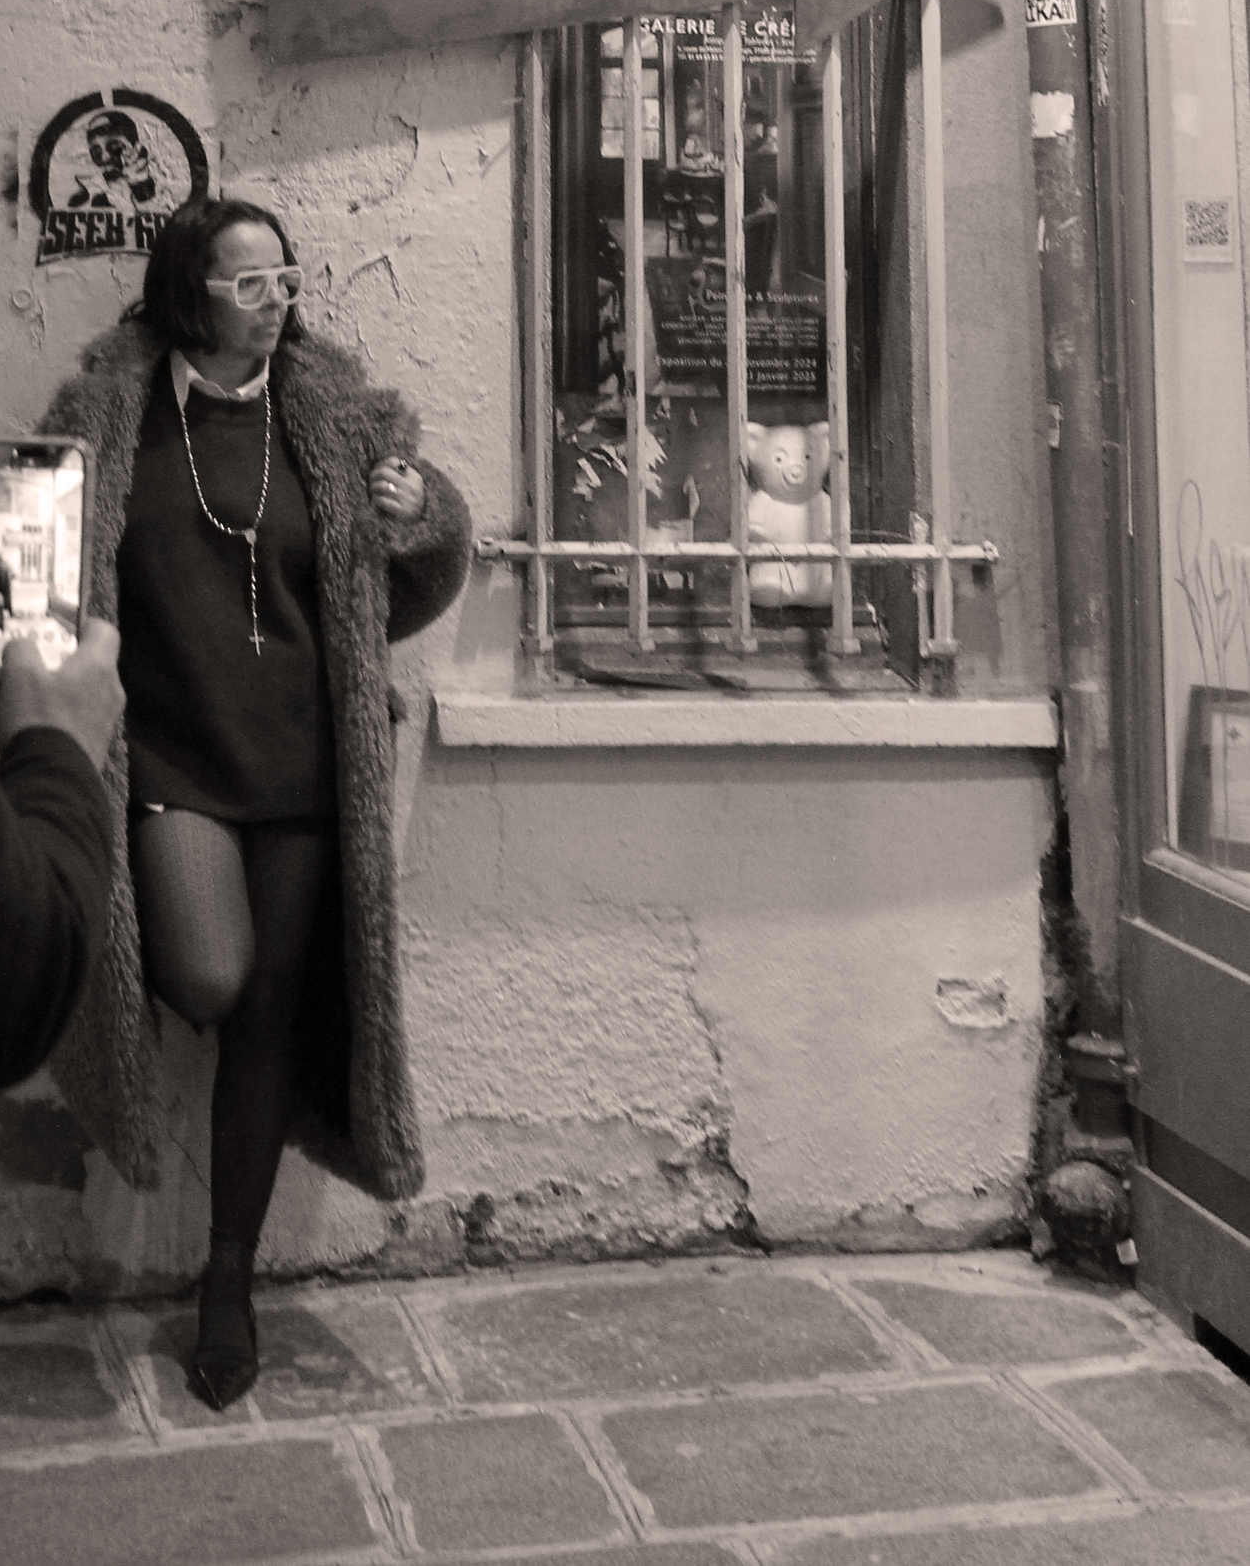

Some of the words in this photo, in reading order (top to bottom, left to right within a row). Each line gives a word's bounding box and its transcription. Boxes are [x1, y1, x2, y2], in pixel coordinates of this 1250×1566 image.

[655, 354, 707, 369] Exposition
[709, 356, 723, 367] du
[744, 357, 791, 369] ovembre
